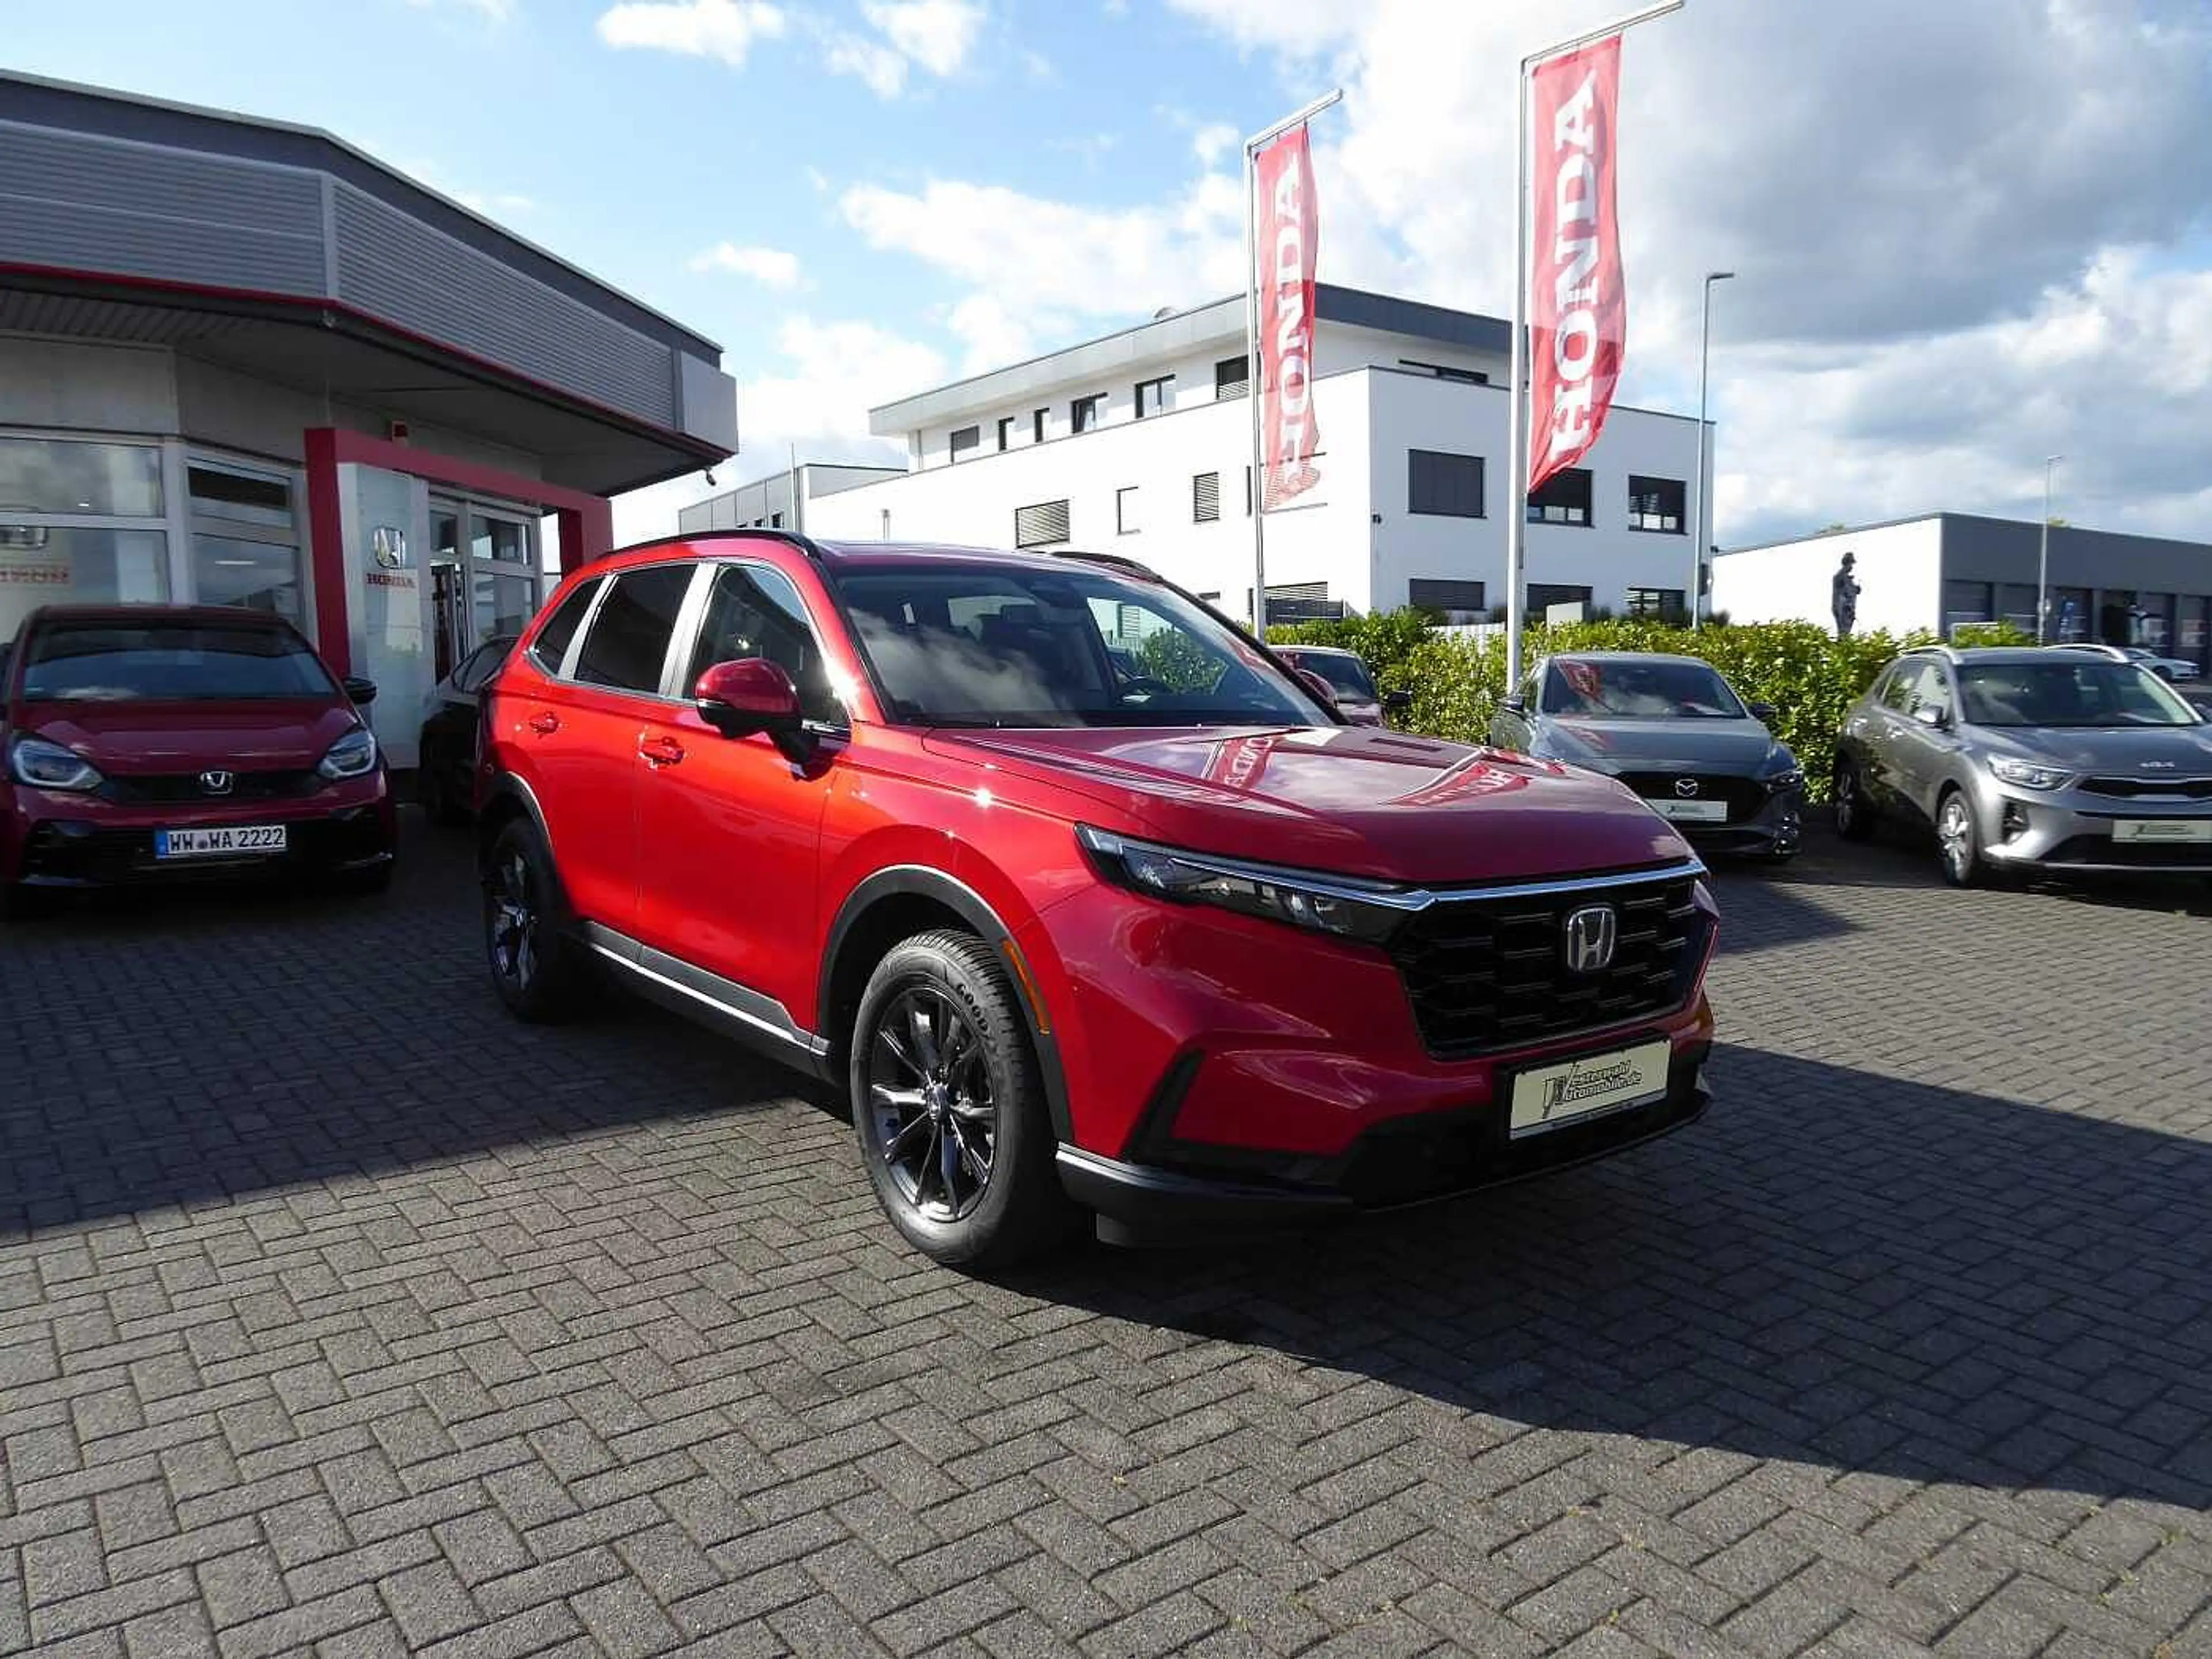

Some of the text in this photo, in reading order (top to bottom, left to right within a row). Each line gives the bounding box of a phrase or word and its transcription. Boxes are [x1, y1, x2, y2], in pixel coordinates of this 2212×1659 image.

[1274, 151, 1309, 485] HONDA
[1548, 68, 1599, 461] HONDA
[238, 828, 285, 847] 2222
